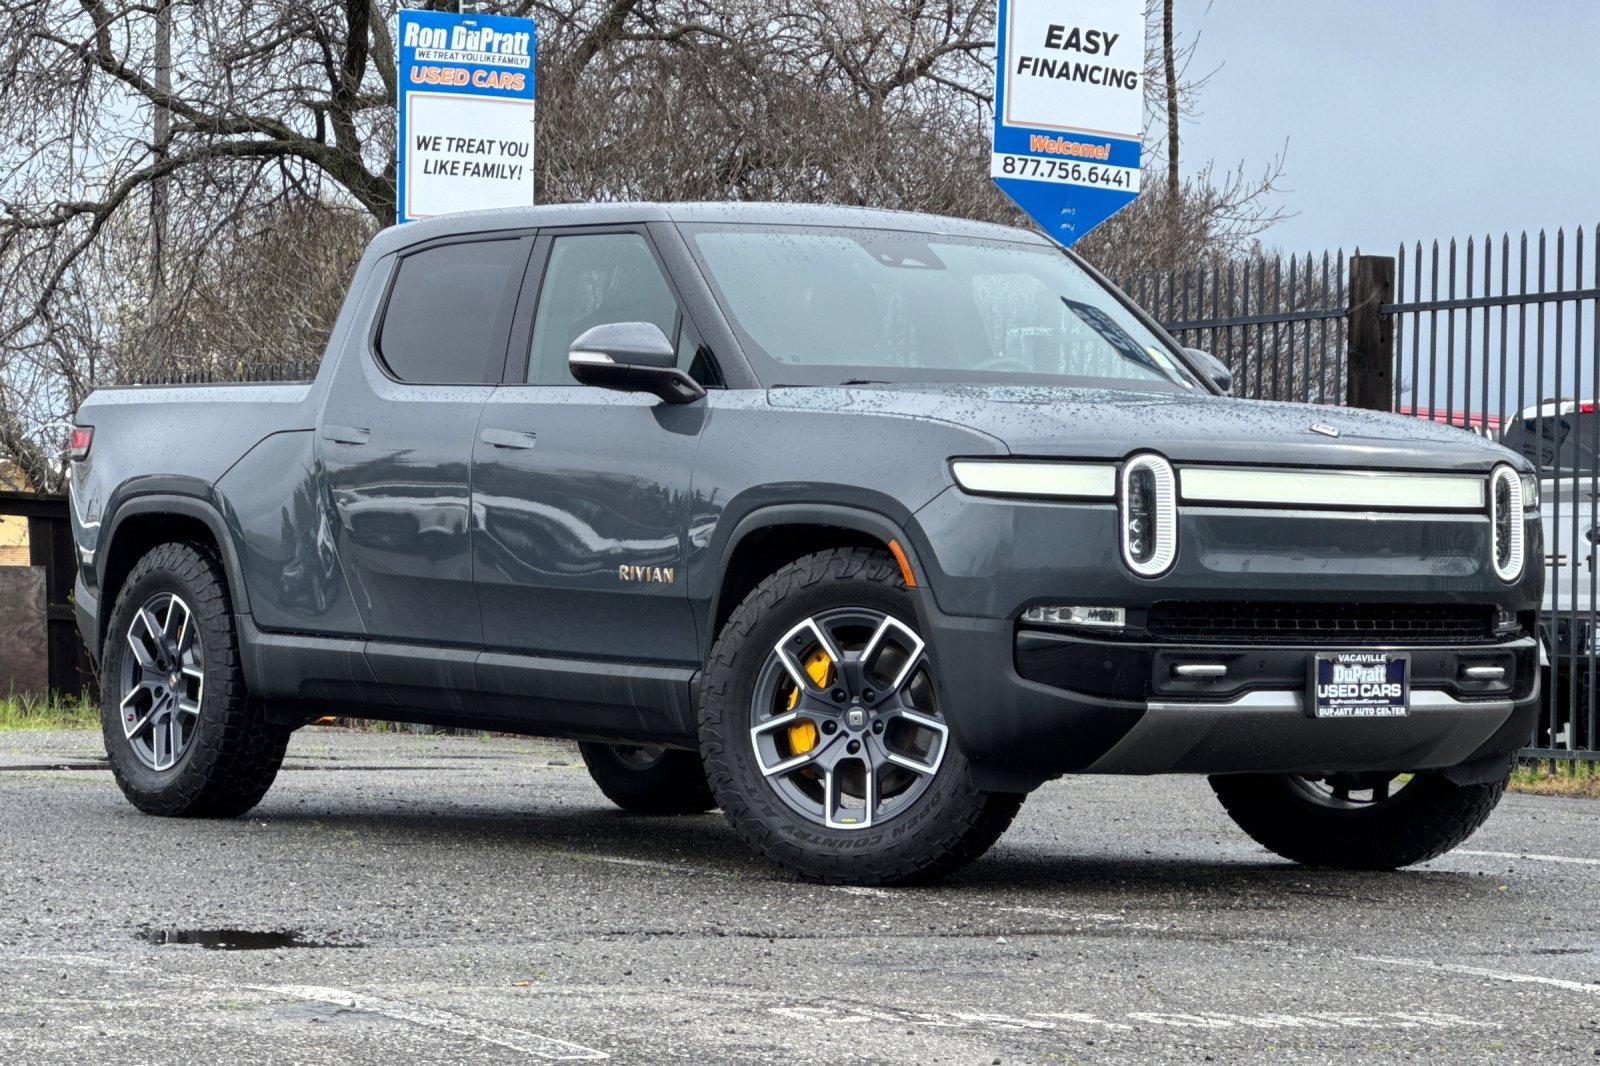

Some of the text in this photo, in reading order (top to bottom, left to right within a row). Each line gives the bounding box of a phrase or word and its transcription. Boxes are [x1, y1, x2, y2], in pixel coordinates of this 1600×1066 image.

[404, 22, 530, 55] Ron DuPratt
[1044, 24, 1120, 56] EASY
[418, 50, 528, 66] WE TREAT YOU LIKE FAMILY!
[410, 65, 525, 91] USED CARS
[1017, 56, 1138, 90] FINANCING
[416, 135, 529, 158] WE TREAT YOU
[1029, 134, 1111, 160] Welcome!
[423, 159, 522, 180] LIKE FAMILY!
[1002, 156, 1131, 188] 877.756.6441
[619, 564, 675, 583] RIVIAN
[1338, 654, 1387, 662] VACAVILLE
[1333, 664, 1387, 683] DuPratt
[1318, 684, 1402, 698] USED CARS
[1354, 707, 1375, 716] AUTO
[892, 790, 941, 838] OPEN
[780, 824, 883, 849] COUNTRY
